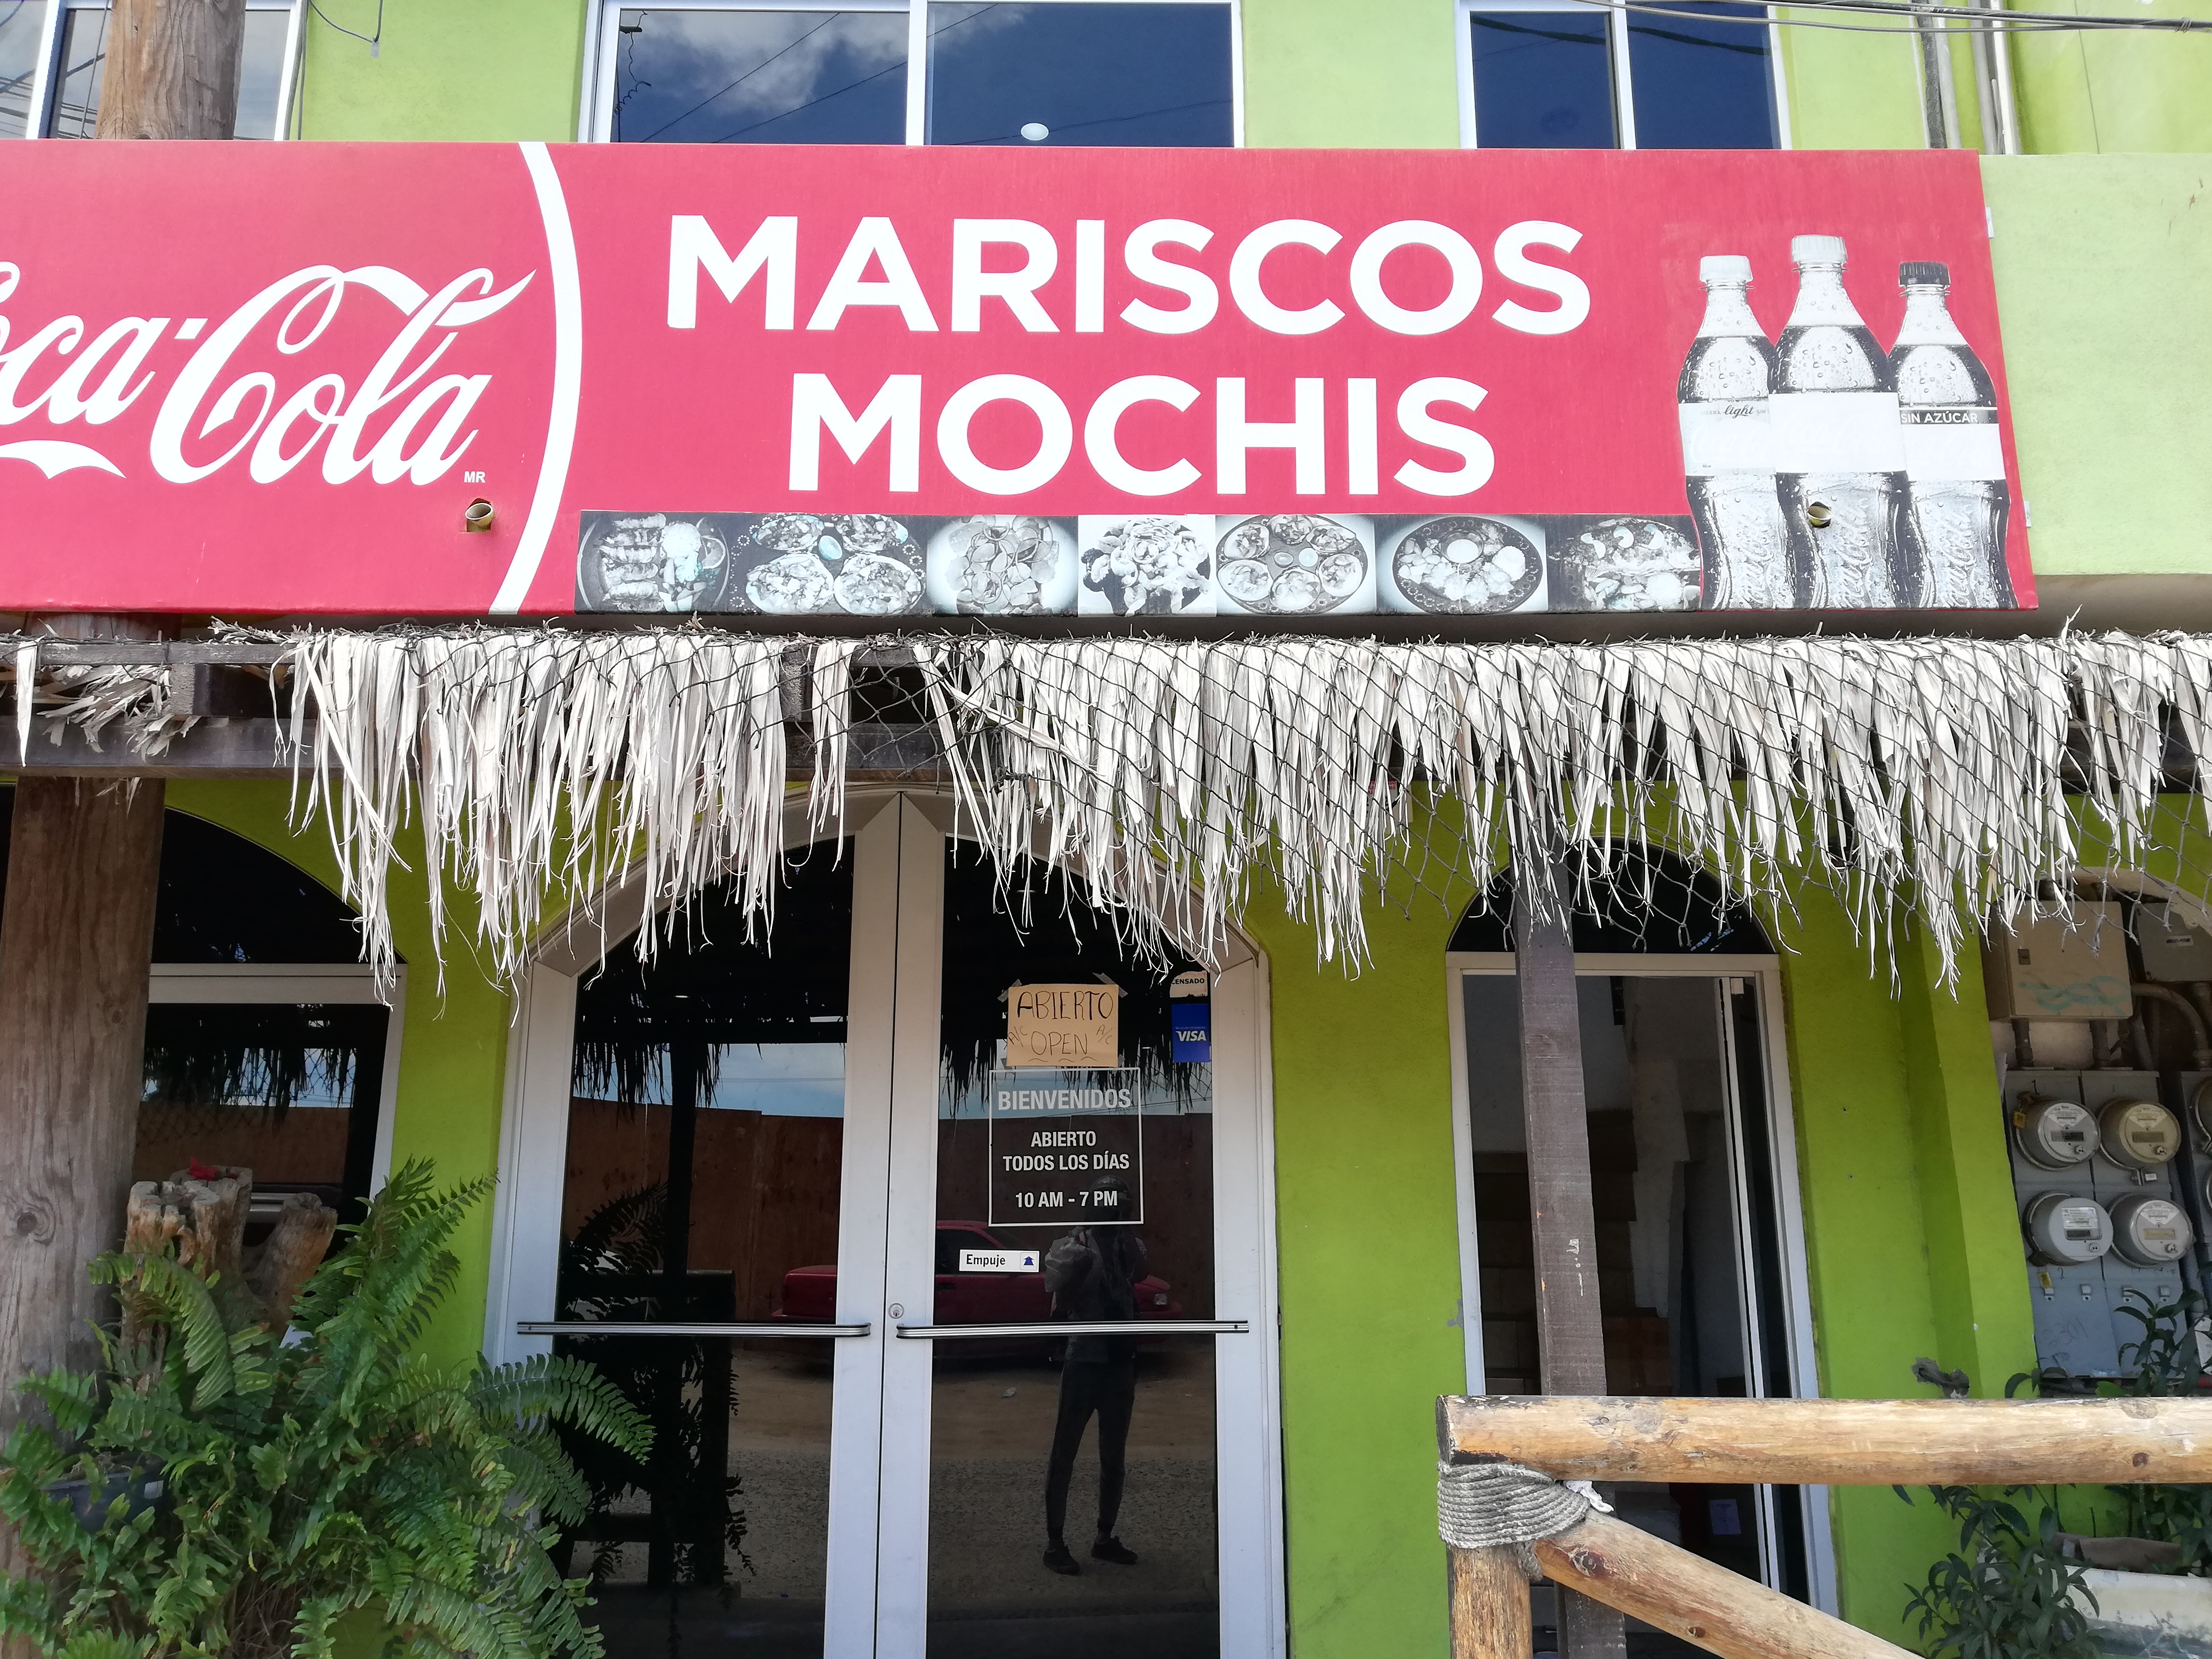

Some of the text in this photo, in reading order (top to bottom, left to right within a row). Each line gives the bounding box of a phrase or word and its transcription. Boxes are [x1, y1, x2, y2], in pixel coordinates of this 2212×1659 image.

[667, 215, 1590, 335] MARISCOS
[0, 261, 536, 485] ca-Cola
[1723, 404, 1753, 419] light
[1901, 410, 1978, 423] SIN AZÚCAR
[789, 373, 1494, 497] MOCHIS
[464, 471, 486, 483] MR
[1017, 990, 1113, 1021] ABIERTO
[1031, 1031, 1088, 1056] OPEN
[1176, 1031, 1206, 1042] VISA
[998, 1089, 1131, 1110] BIENVENIDOS
[1031, 1131, 1096, 1147] ABIERTO
[1003, 1151, 1130, 1171] TODOS LOS DÍAS
[1015, 1192, 1034, 1207] 10
[1038, 1192, 1063, 1207] AM
[1080, 1191, 1089, 1206] 7
[1094, 1190, 1118, 1206] PM
[966, 1254, 1006, 1267] Empuje
